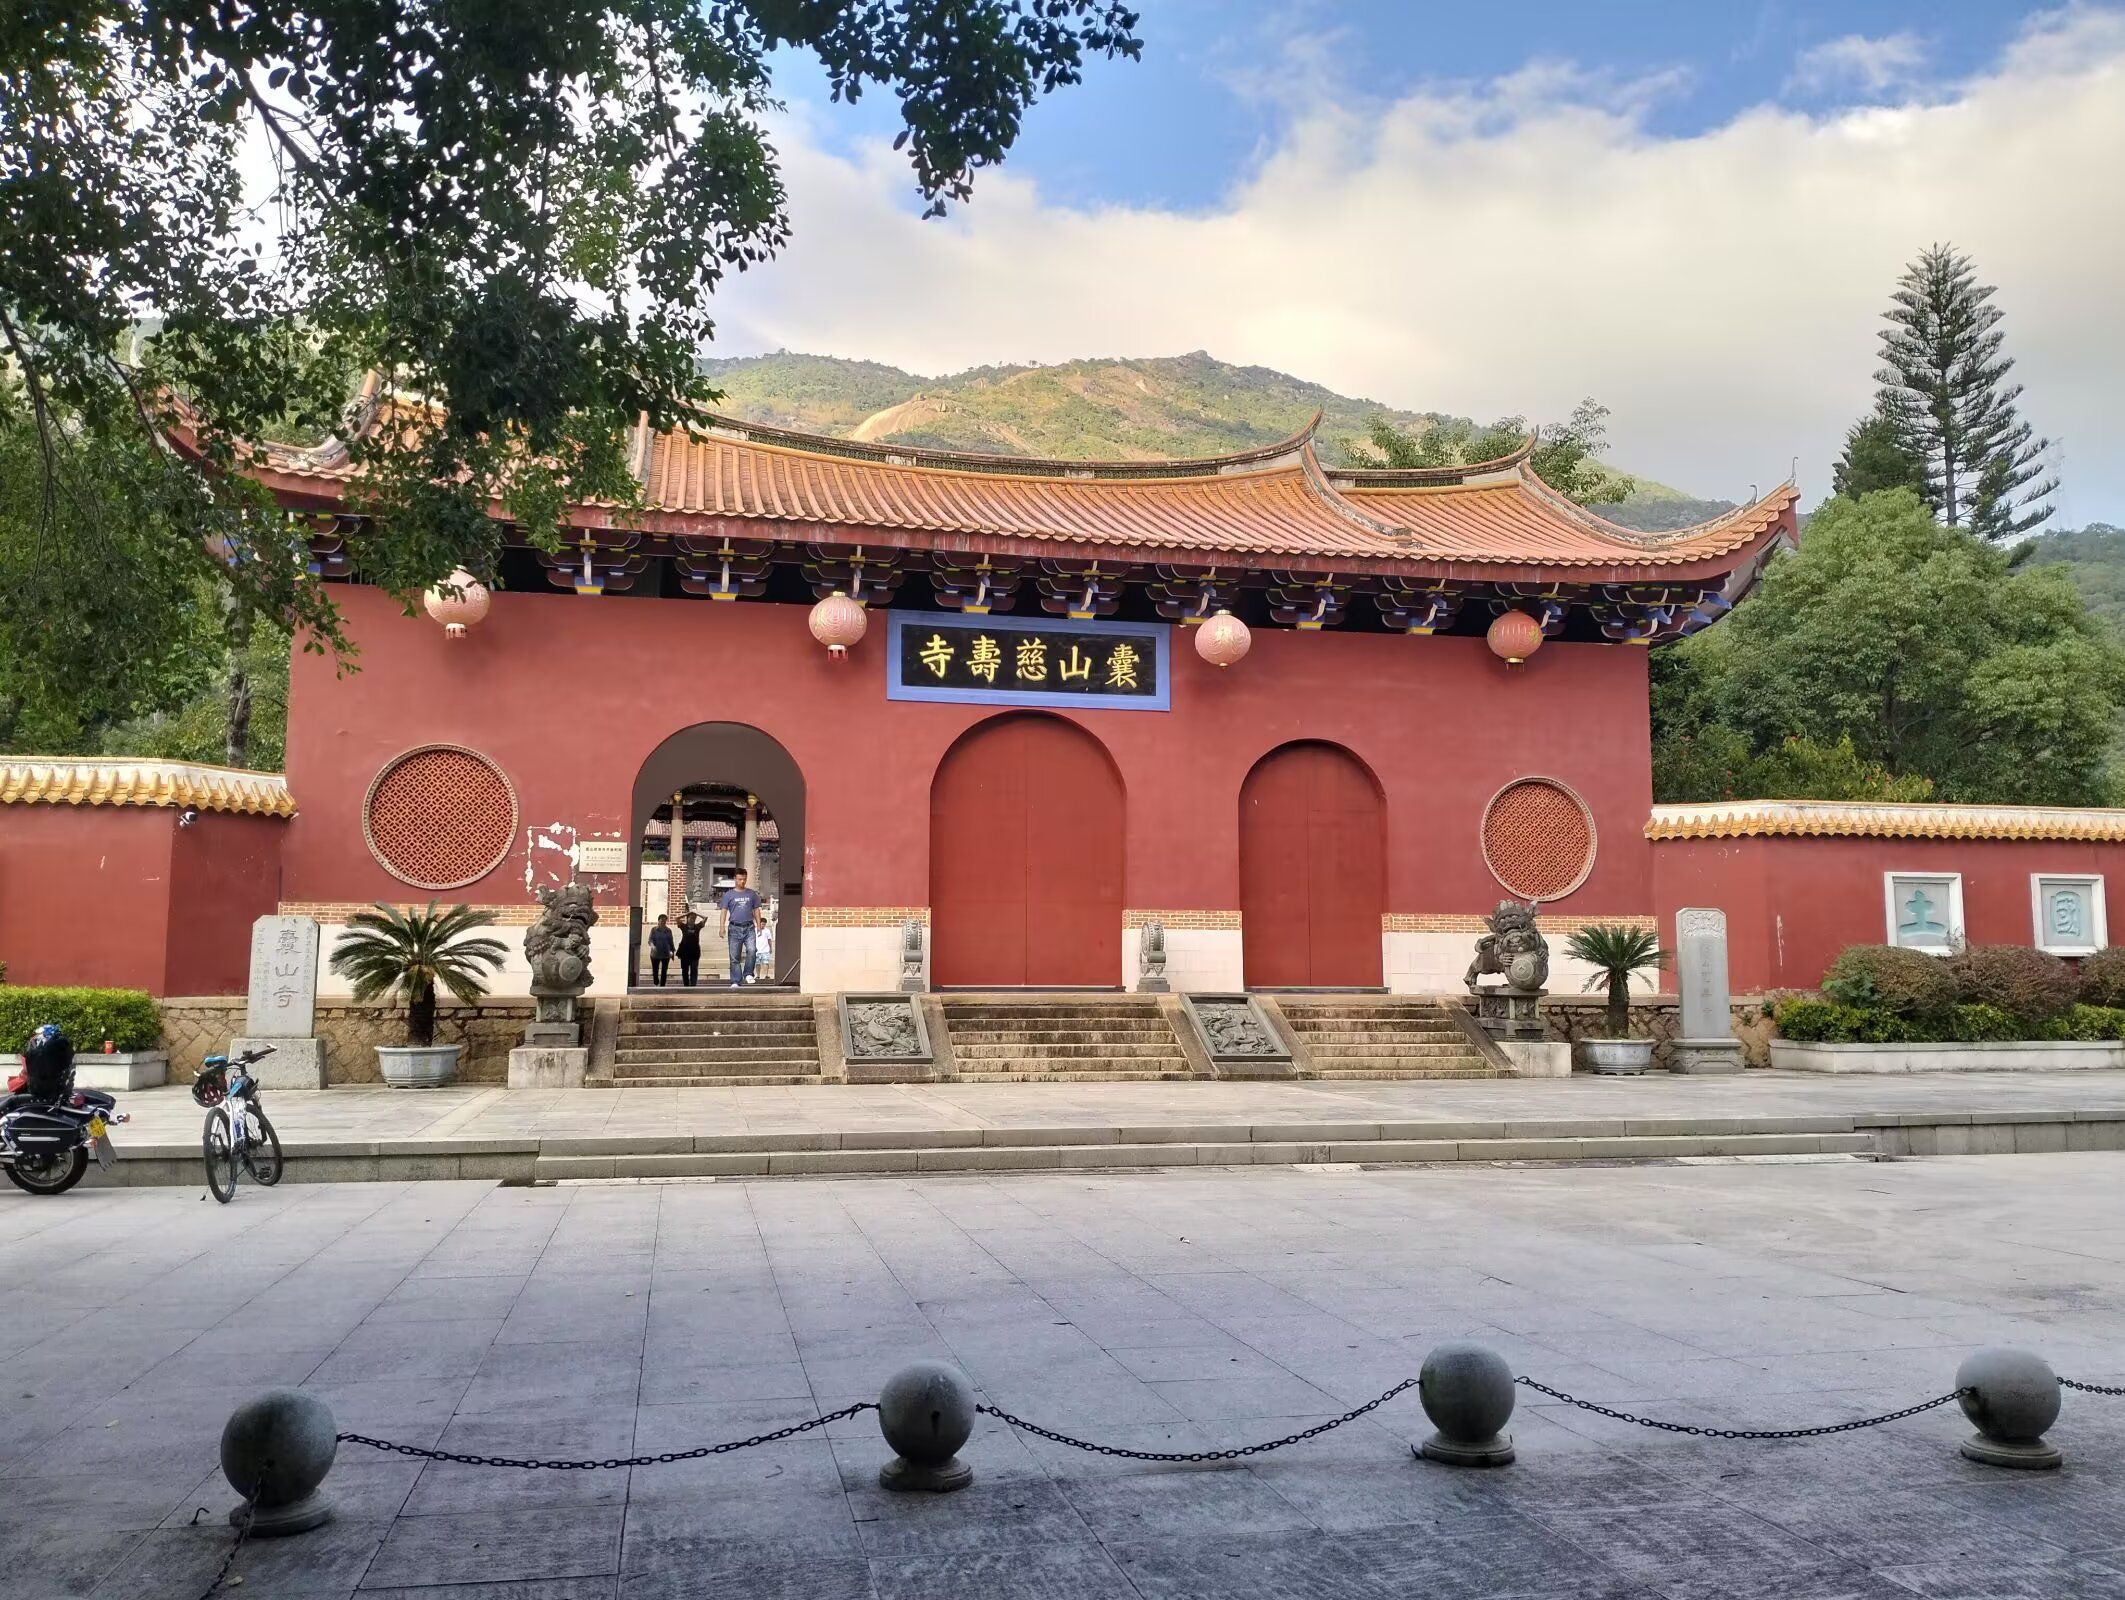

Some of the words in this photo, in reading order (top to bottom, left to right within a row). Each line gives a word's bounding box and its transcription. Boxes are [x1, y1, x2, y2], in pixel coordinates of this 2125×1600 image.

[919, 633, 1139, 688] 囊山慈壽寺
